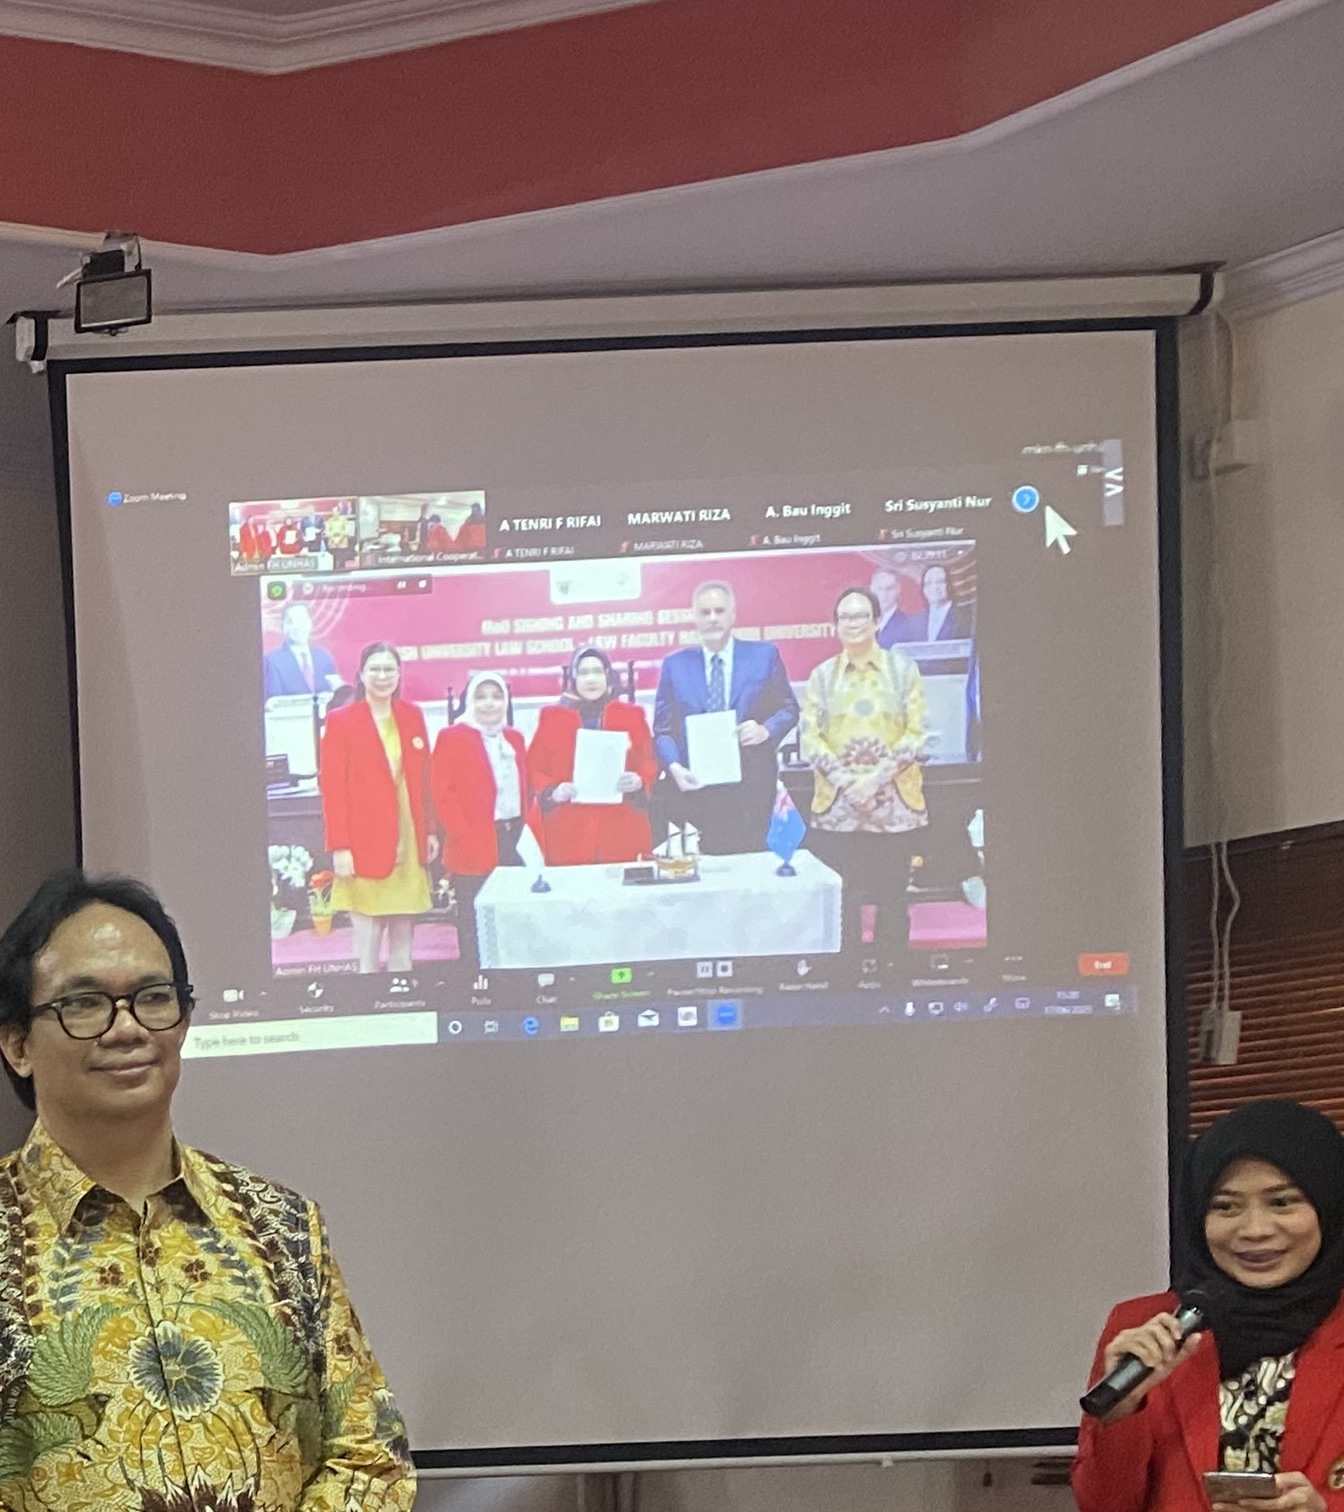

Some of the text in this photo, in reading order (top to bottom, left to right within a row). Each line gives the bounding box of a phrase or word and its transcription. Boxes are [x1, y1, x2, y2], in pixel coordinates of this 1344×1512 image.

[123, 490, 188, 503] Zoom Meeting
[885, 496, 993, 513] Sri Susyanti Nur
[628, 508, 731, 525] MARWATI RIZA
[765, 503, 852, 519] A. Bau Inggit
[499, 515, 601, 532] A TENRI F RIFAI
[378, 551, 434, 564] International
[193, 1031, 300, 1050] Type here to search
